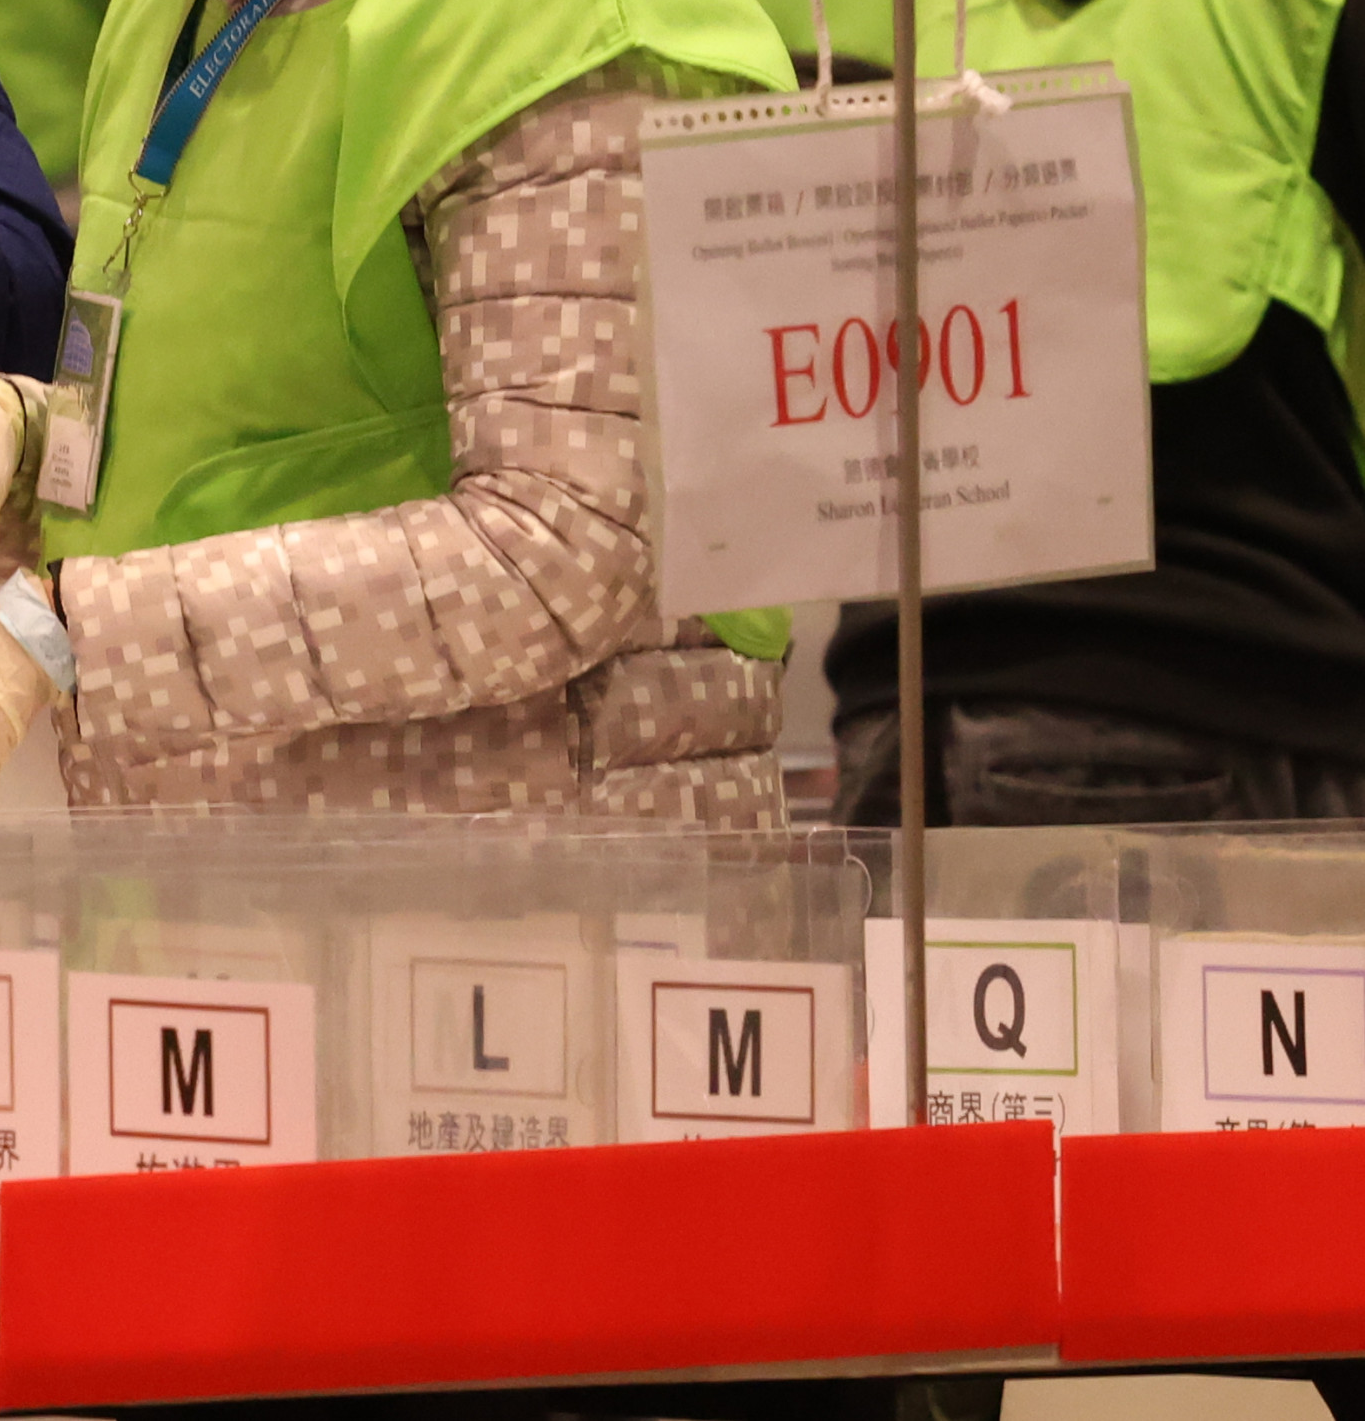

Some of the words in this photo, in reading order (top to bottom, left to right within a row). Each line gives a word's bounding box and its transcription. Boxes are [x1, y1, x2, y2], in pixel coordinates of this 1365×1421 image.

[956, 480, 1011, 506] School
[471, 984, 510, 1072] L
[707, 1007, 763, 1098] M
[973, 963, 1027, 1058] Q
[1260, 990, 1308, 1078] N
[160, 1026, 214, 1117] M
[407, 1110, 570, 1152] 地產及建造界
